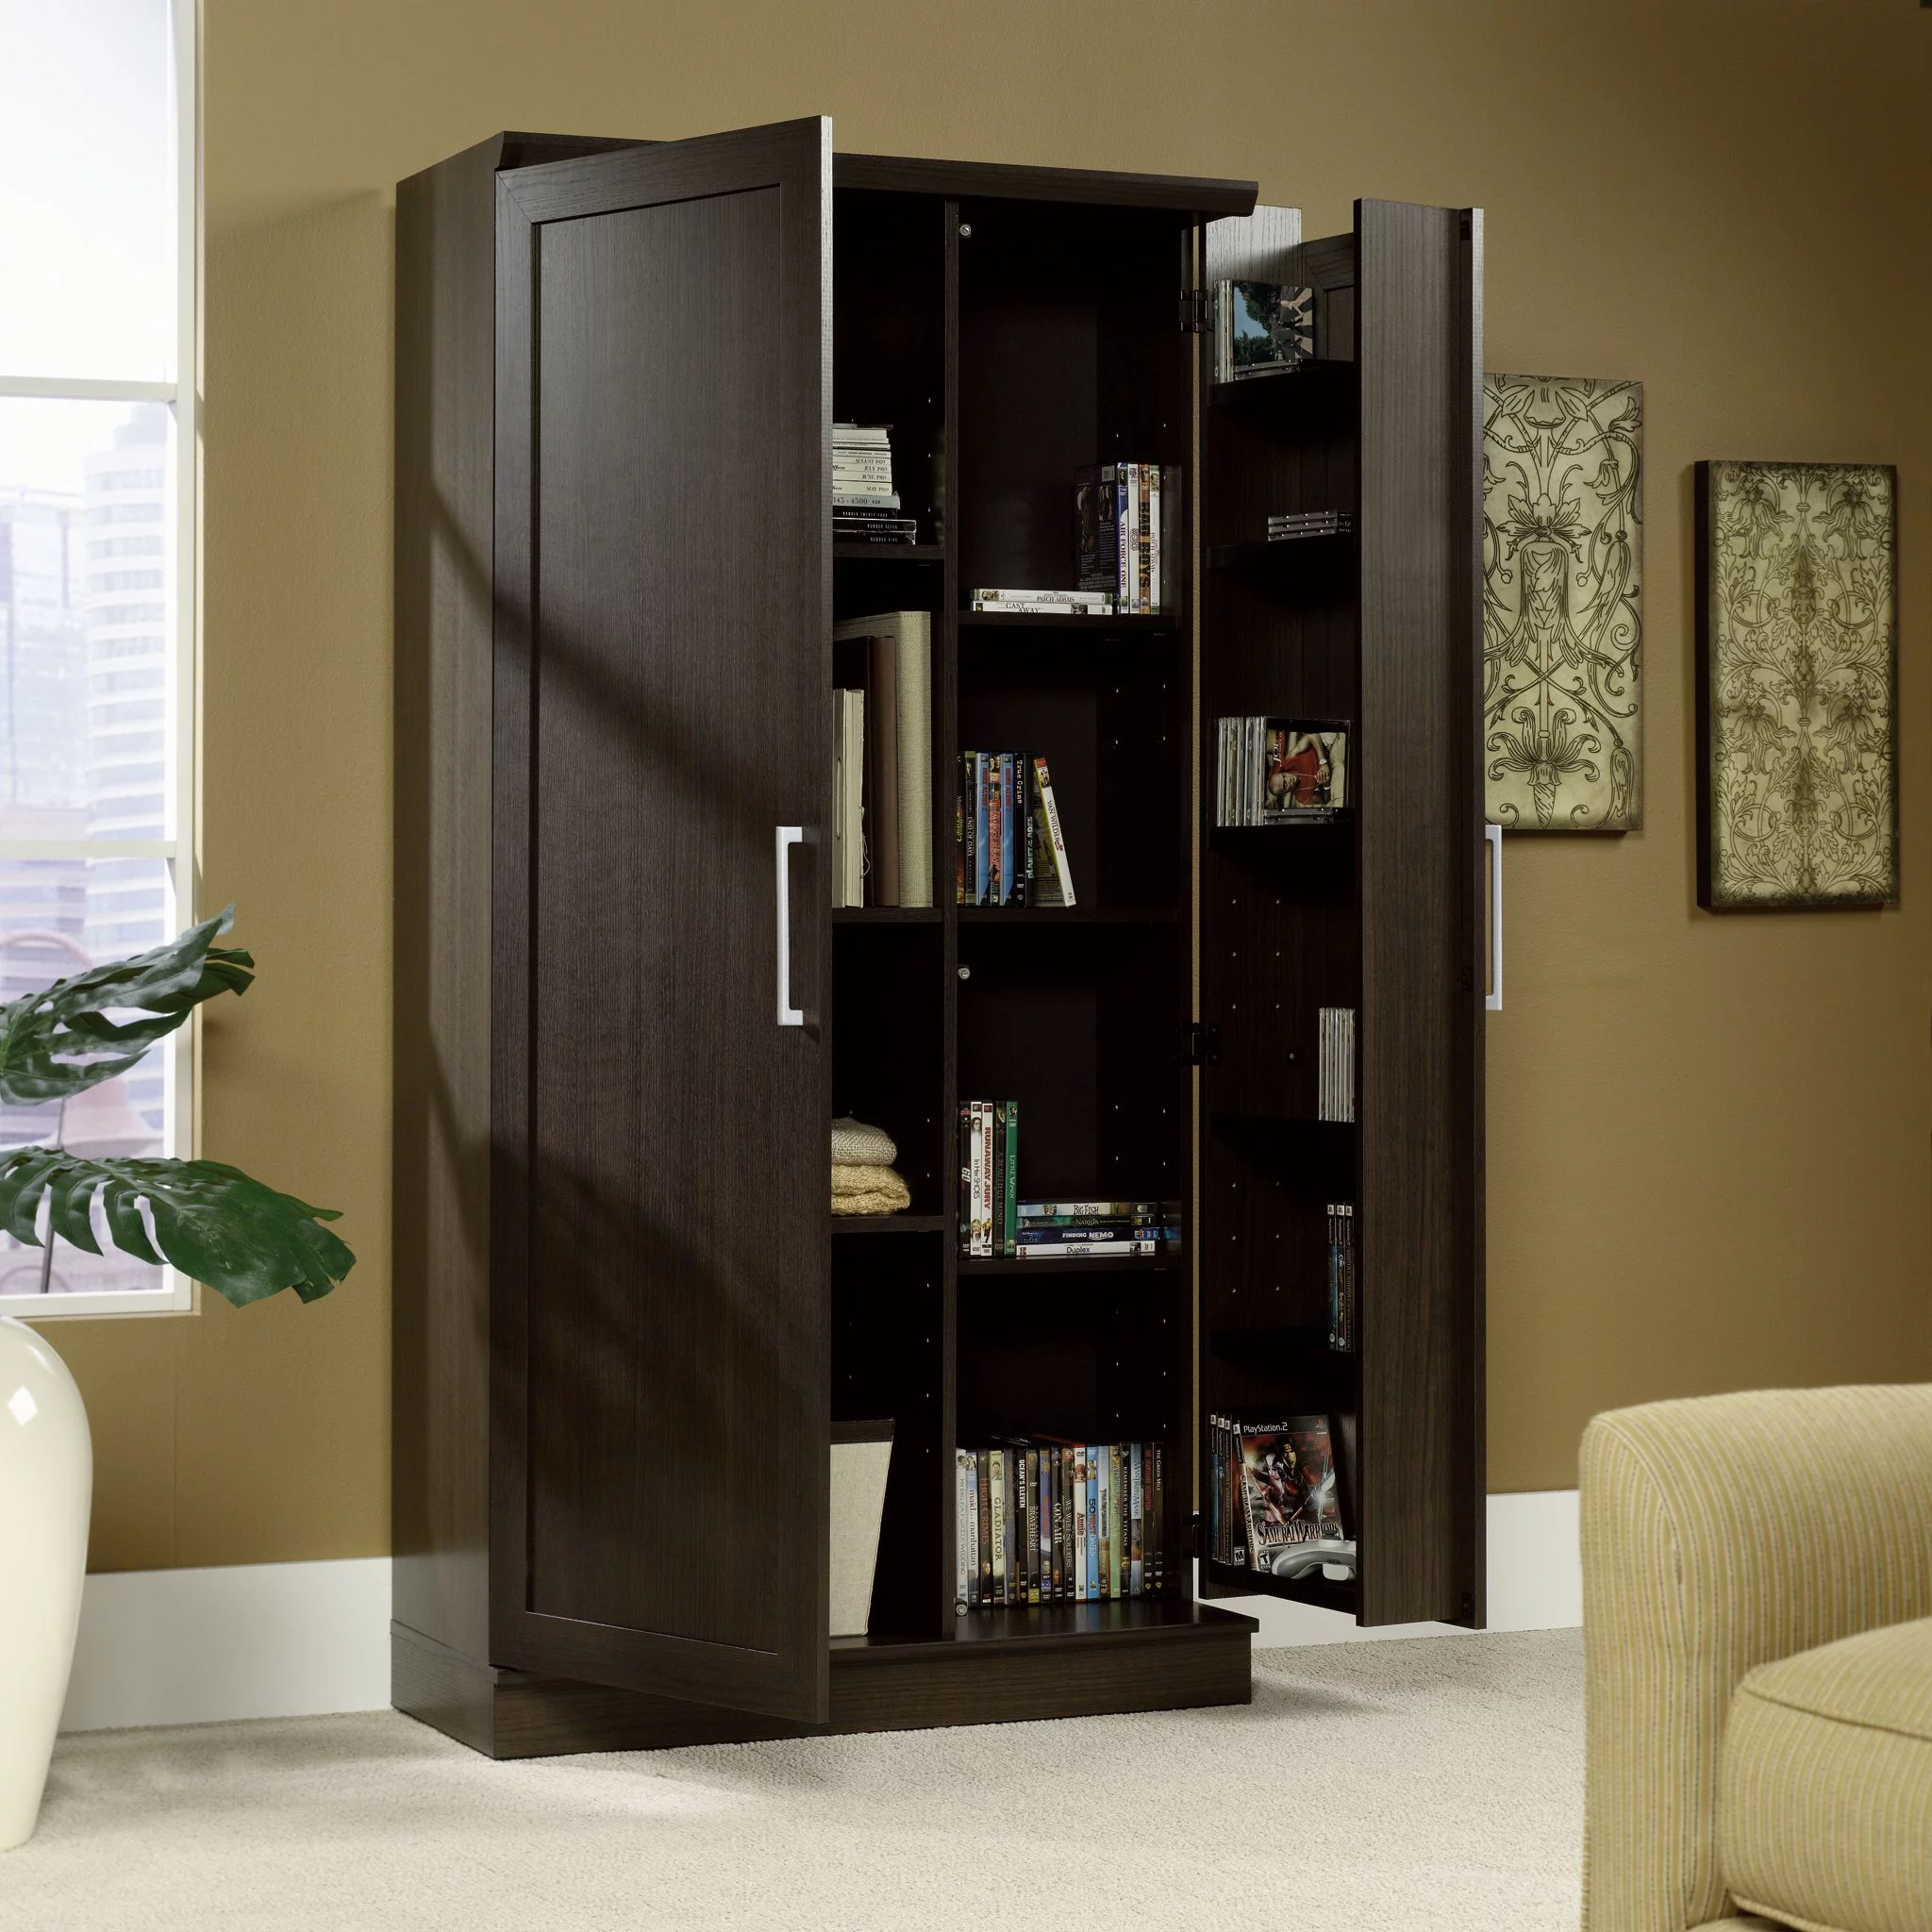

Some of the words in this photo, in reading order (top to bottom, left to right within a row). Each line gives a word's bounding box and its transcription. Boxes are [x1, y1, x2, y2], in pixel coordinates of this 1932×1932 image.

[1140, 542, 1150, 588] BOYS
[1050, 816, 1060, 842] WILDER
[1089, 1231, 1114, 1240] NEMO
[969, 1490, 977, 1511] maid
[1065, 1499, 1072, 1511] WE
[1257, 1521, 1296, 1546] SAMURAI
